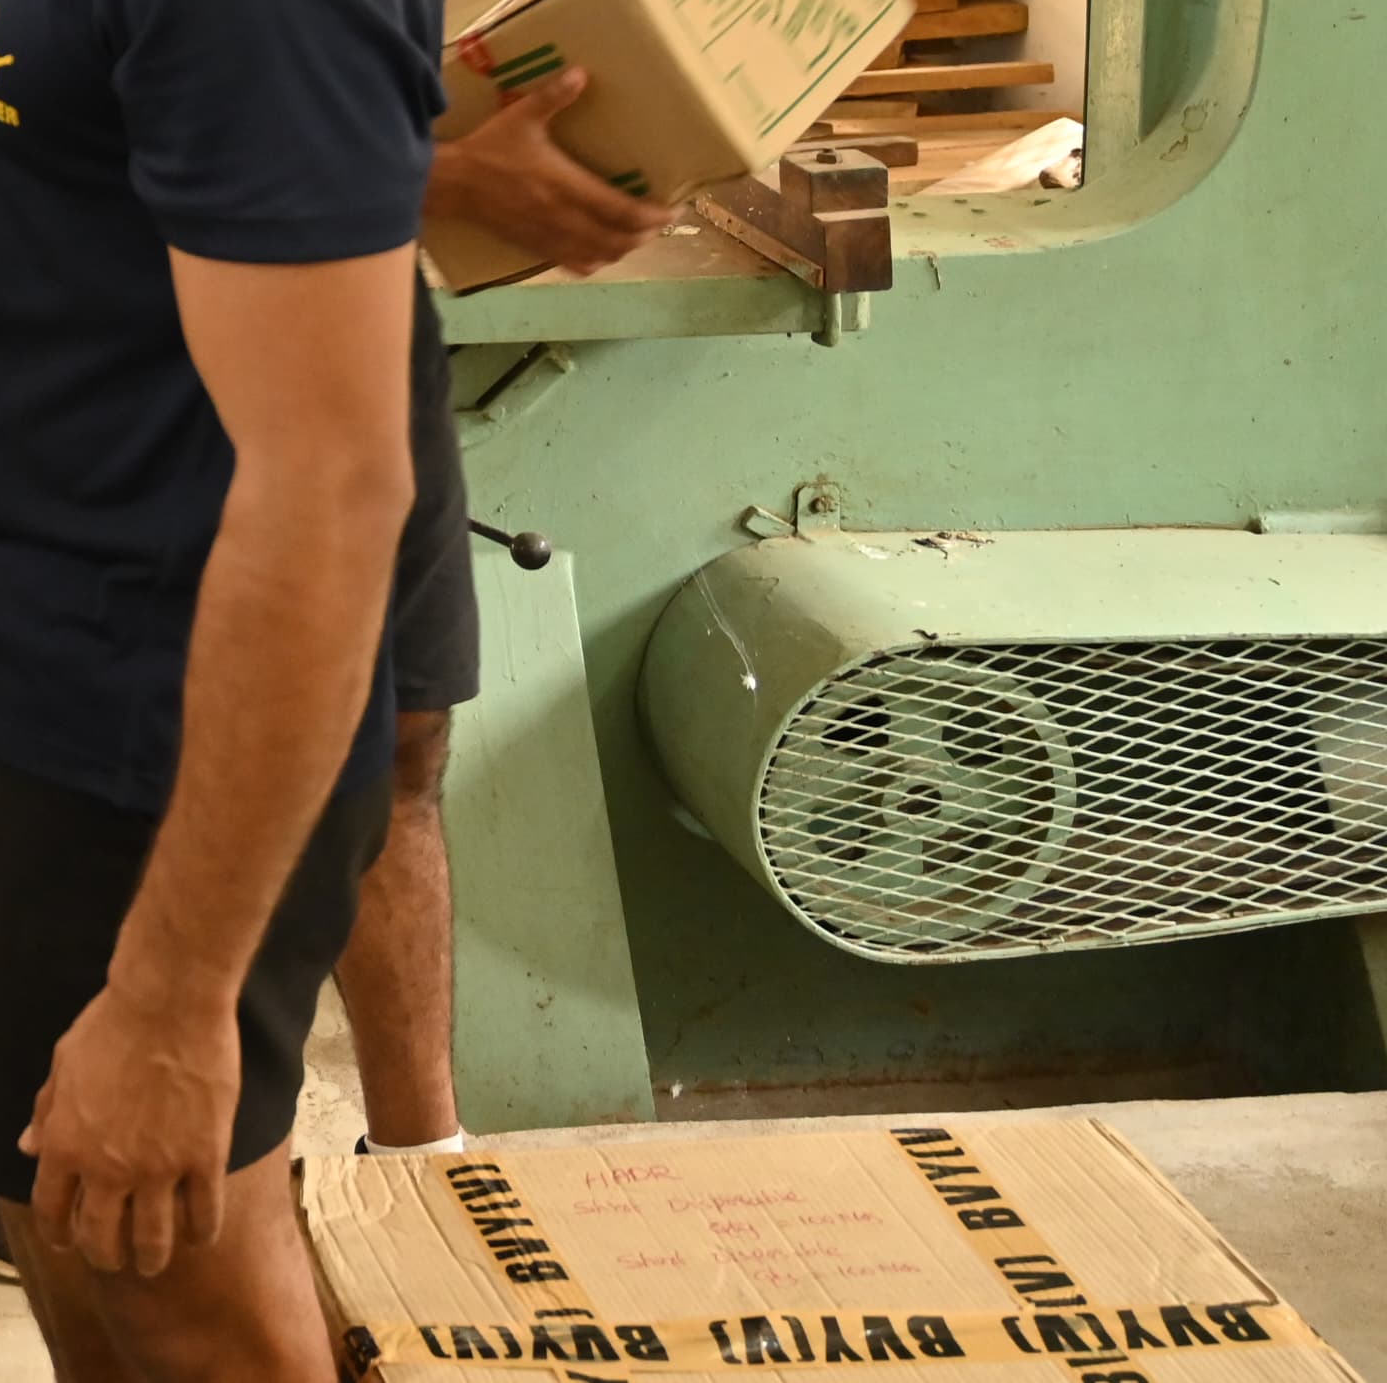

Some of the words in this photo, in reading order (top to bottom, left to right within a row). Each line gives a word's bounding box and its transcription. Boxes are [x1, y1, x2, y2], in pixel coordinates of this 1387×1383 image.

[585, 1165, 683, 1190] HADR
[708, 1315, 967, 1366] BVY(V)
[1001, 1303, 1272, 1354] BVY(V)
